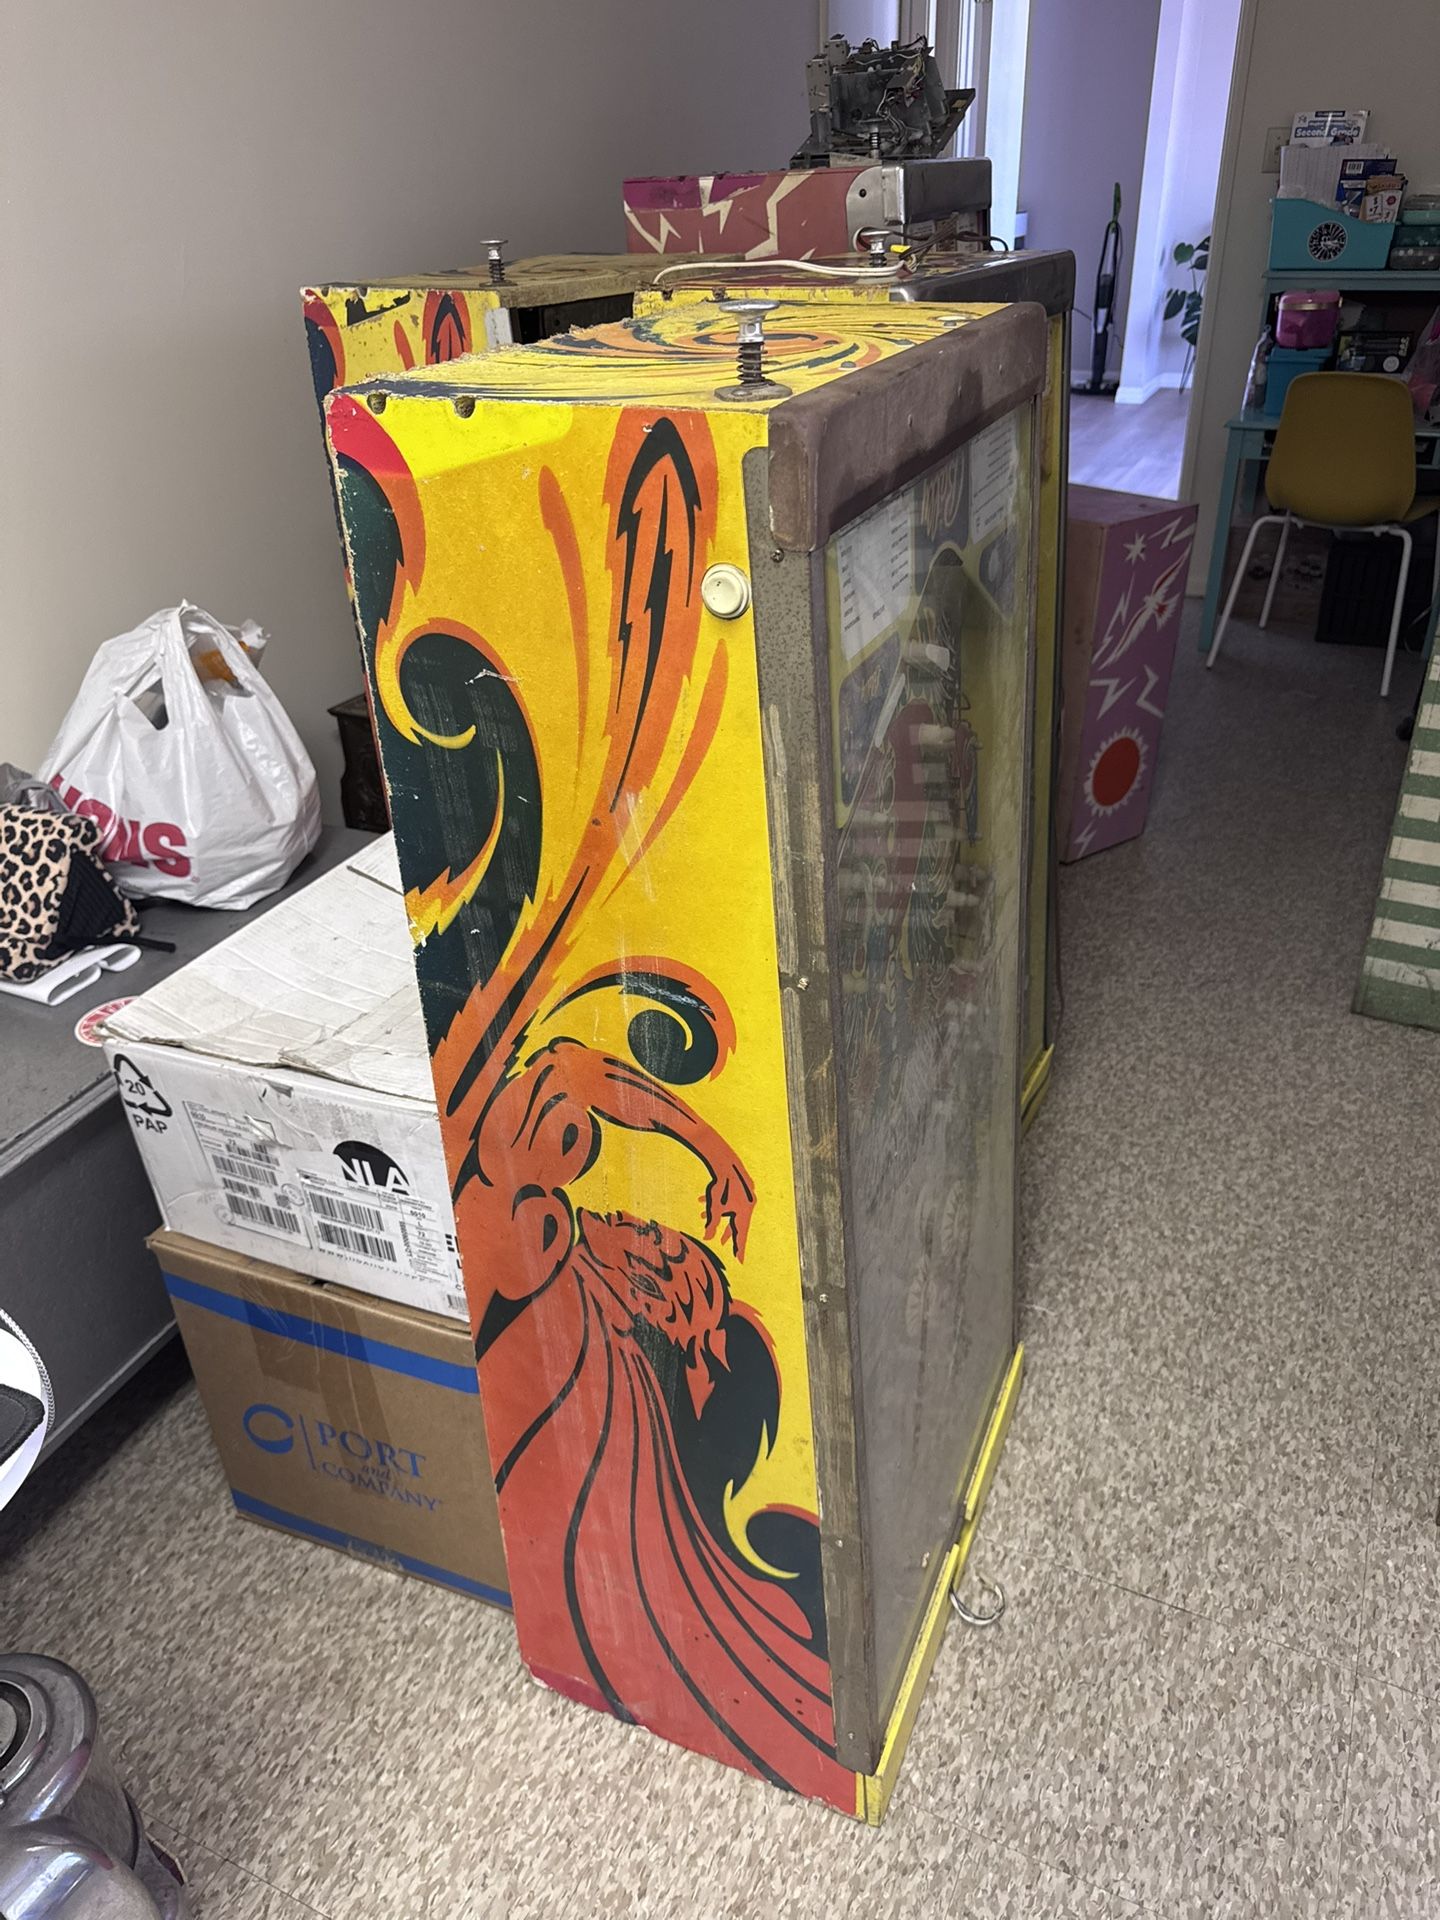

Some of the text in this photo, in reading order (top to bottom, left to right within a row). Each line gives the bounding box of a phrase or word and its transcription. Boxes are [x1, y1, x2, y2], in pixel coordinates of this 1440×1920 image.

[1296, 127, 1326, 137] Second
[125, 1079, 146, 1096] 20
[132, 1113, 168, 1134] PAP
[315, 1419, 426, 1479] PORT
[361, 1465, 391, 1481] and
[321, 1461, 437, 1512] COMPANY
